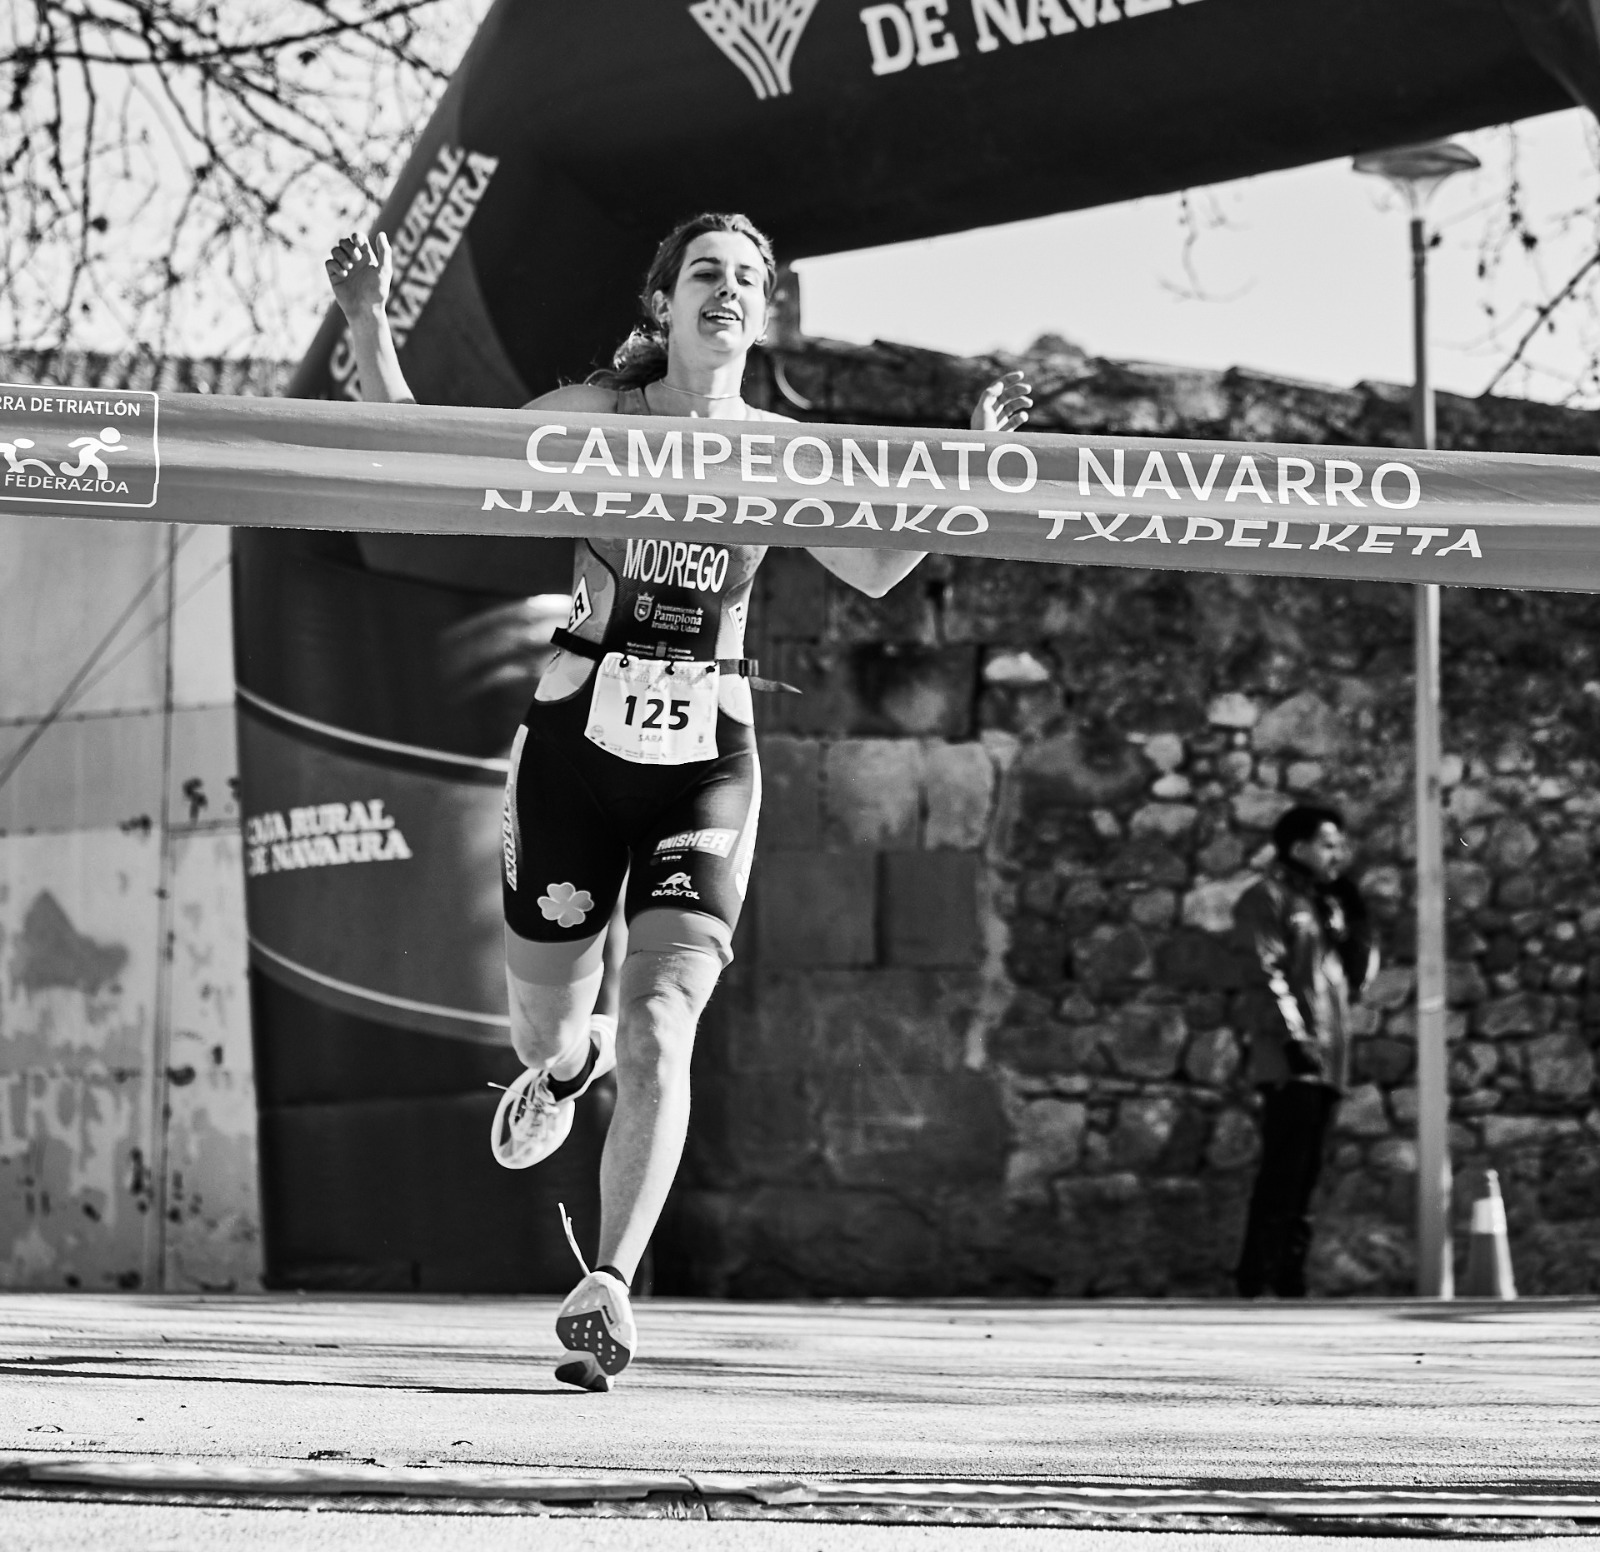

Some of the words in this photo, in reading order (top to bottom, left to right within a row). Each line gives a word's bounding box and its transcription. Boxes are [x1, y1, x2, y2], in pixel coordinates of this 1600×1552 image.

[860, 0, 959, 75] DE
[0, 396, 26, 412] RA
[30, 397, 53, 413] DE
[56, 398, 141, 417] TRIATLÓN
[4, 474, 129, 494] FEDERAZIOA
[525, 424, 1038, 493] CAMPEONATO
[1077, 446, 1421, 510] NAVARRO
[481, 489, 990, 536] NAFARROAKO
[1038, 510, 1483, 559] TXAPELKETA
[622, 538, 730, 594] MODREGO
[653, 609, 703, 626] Pamplona
[624, 694, 691, 731] 125
[638, 734, 664, 743] SARA
[289, 798, 396, 838] RURAL
[271, 828, 414, 872] NAVARRA
[656, 831, 732, 853] FINISHER
